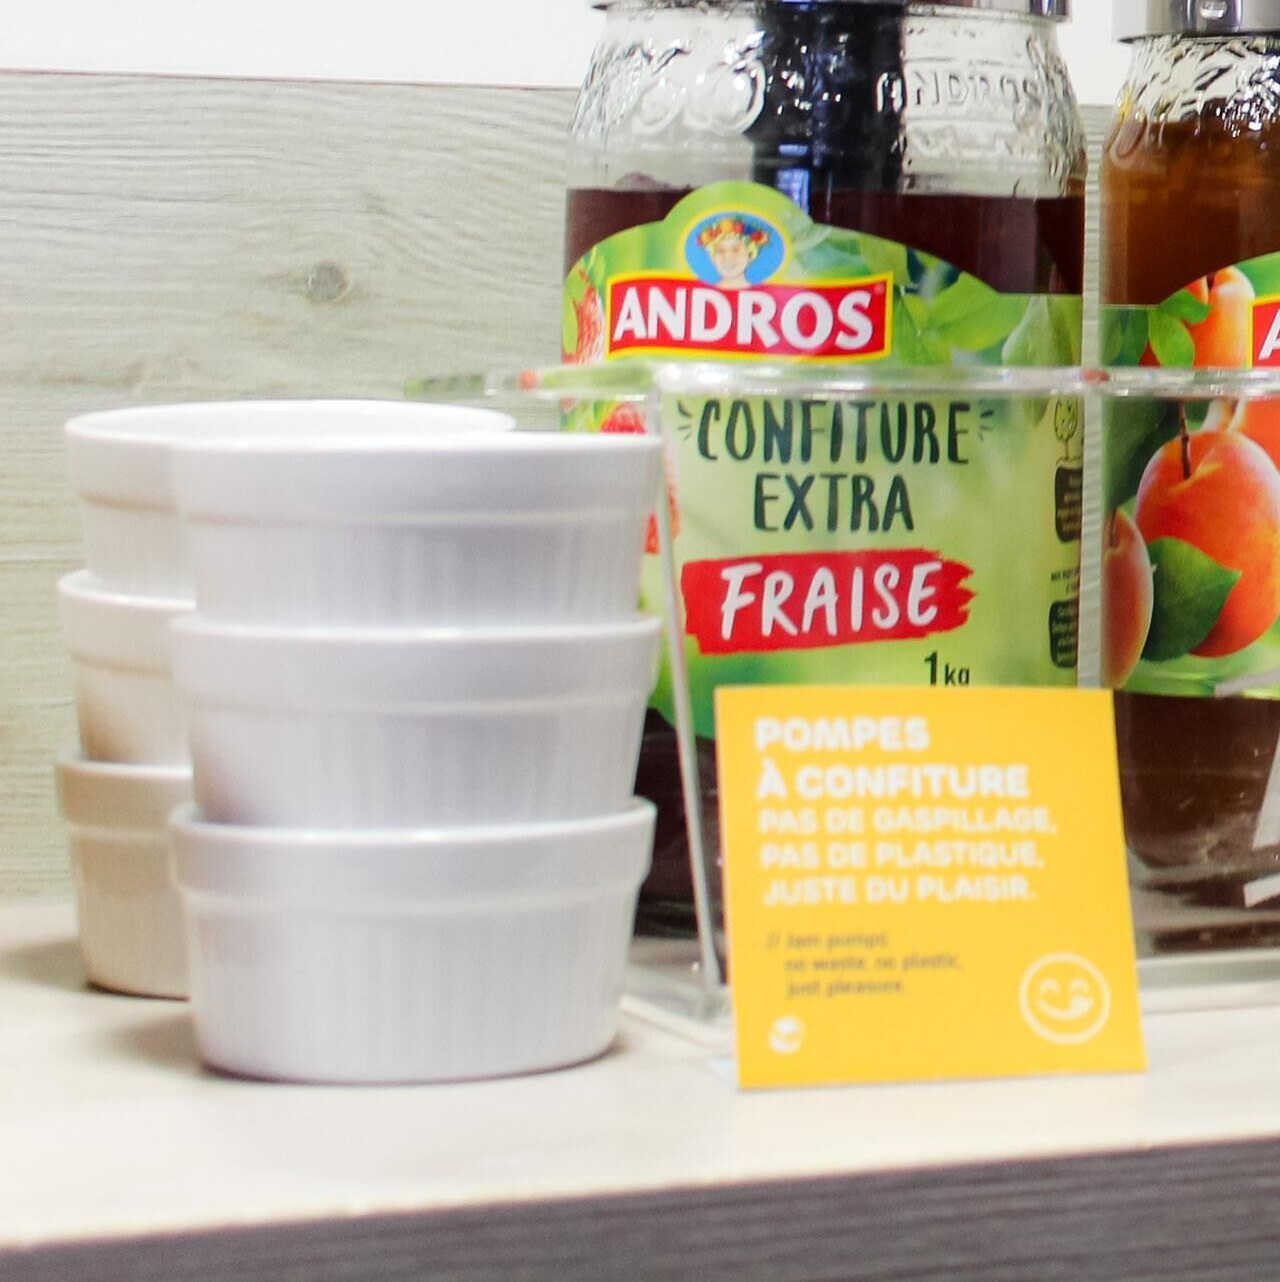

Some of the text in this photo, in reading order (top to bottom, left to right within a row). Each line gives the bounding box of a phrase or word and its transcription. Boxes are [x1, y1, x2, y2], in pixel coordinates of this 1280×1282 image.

[613, 286, 873, 350] ANDROS
[698, 399, 970, 465] CONFITURE
[754, 473, 914, 532] EXTRA
[720, 561, 942, 641] FRAISE
[755, 716, 930, 751] POMPES
[757, 757, 1030, 799] À CONFITURE
[759, 807, 818, 834] PAS
[825, 807, 864, 833] DE
[761, 843, 820, 869] PAS
[828, 842, 866, 867] DE
[764, 877, 857, 906] JUSTE
[866, 876, 909, 903] DU
